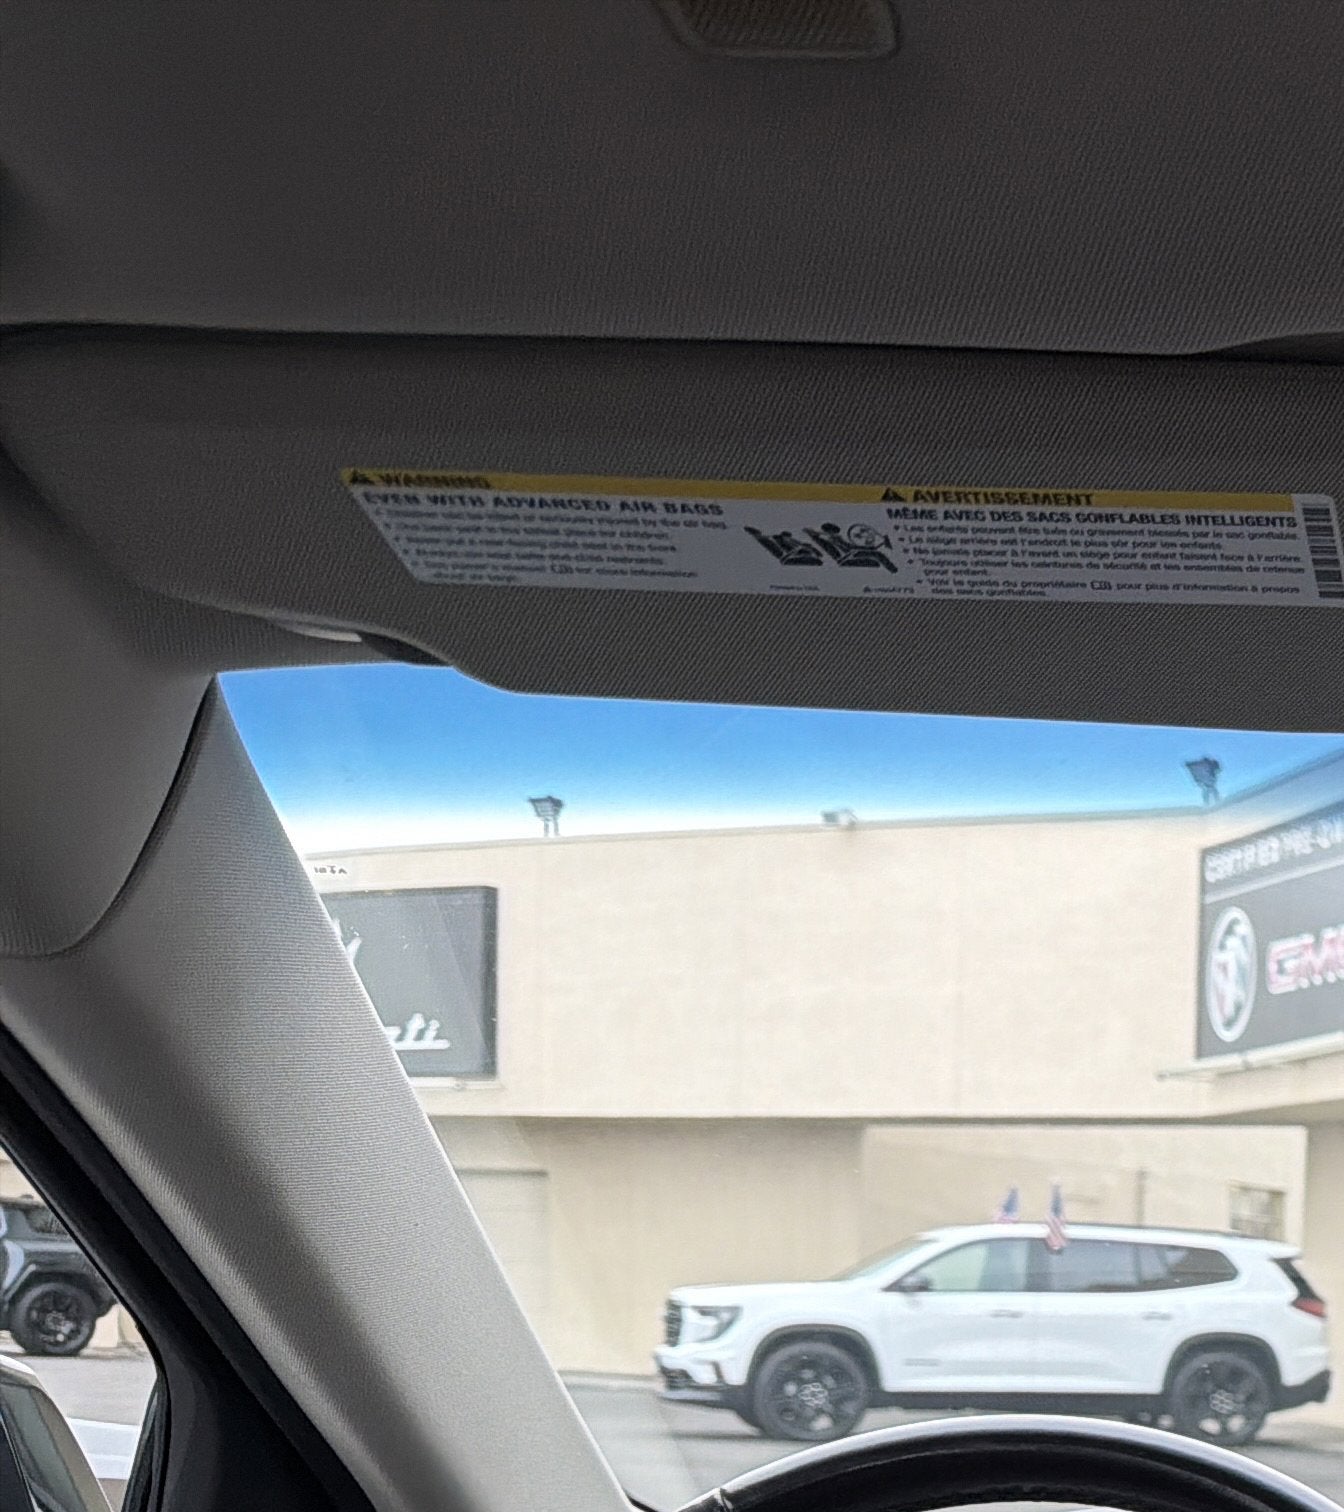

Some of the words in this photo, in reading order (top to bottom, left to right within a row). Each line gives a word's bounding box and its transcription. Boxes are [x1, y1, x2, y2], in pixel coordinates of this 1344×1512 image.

[424, 494, 487, 506] WITH
[488, 496, 612, 510] ADVANCED
[615, 500, 658, 512] AIR
[661, 502, 724, 514] BAGS
[908, 489, 1094, 507] AVERTISSEMENT
[939, 508, 986, 521] AVEC
[988, 509, 1023, 521] DES
[1024, 510, 1072, 523] SACS
[1073, 511, 1181, 525] GONFLABLES
[1183, 513, 1297, 528] INTELLIGENTS
